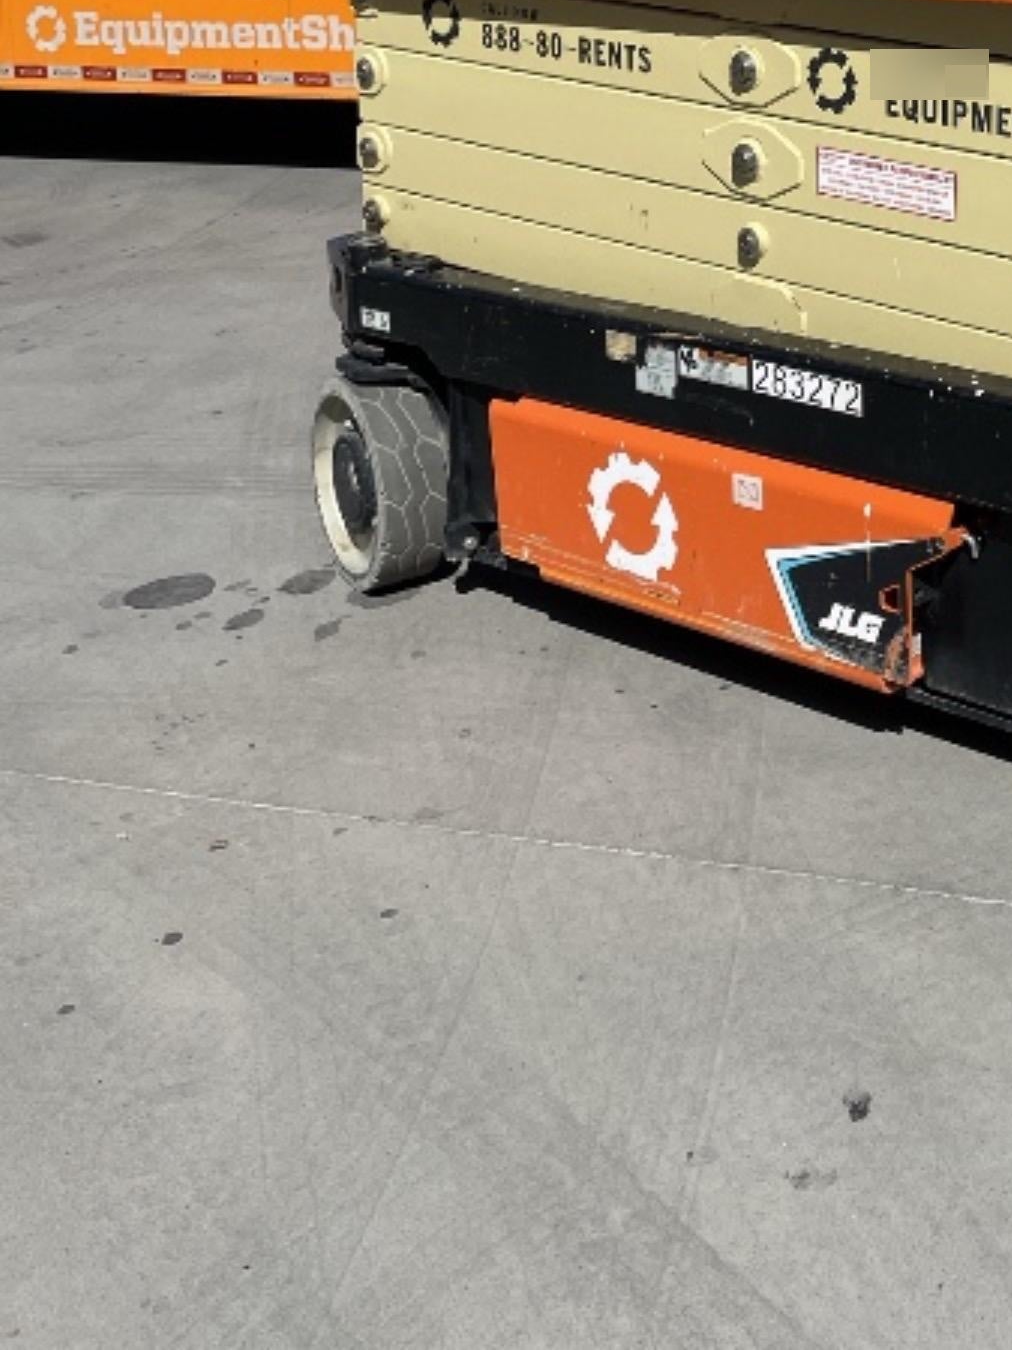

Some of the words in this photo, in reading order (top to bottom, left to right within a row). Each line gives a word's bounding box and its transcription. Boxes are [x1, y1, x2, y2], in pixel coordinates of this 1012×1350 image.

[481, 23, 652, 73] 888-80-RENTS
[754, 360, 862, 416] 283272
[818, 601, 887, 644] JLG
